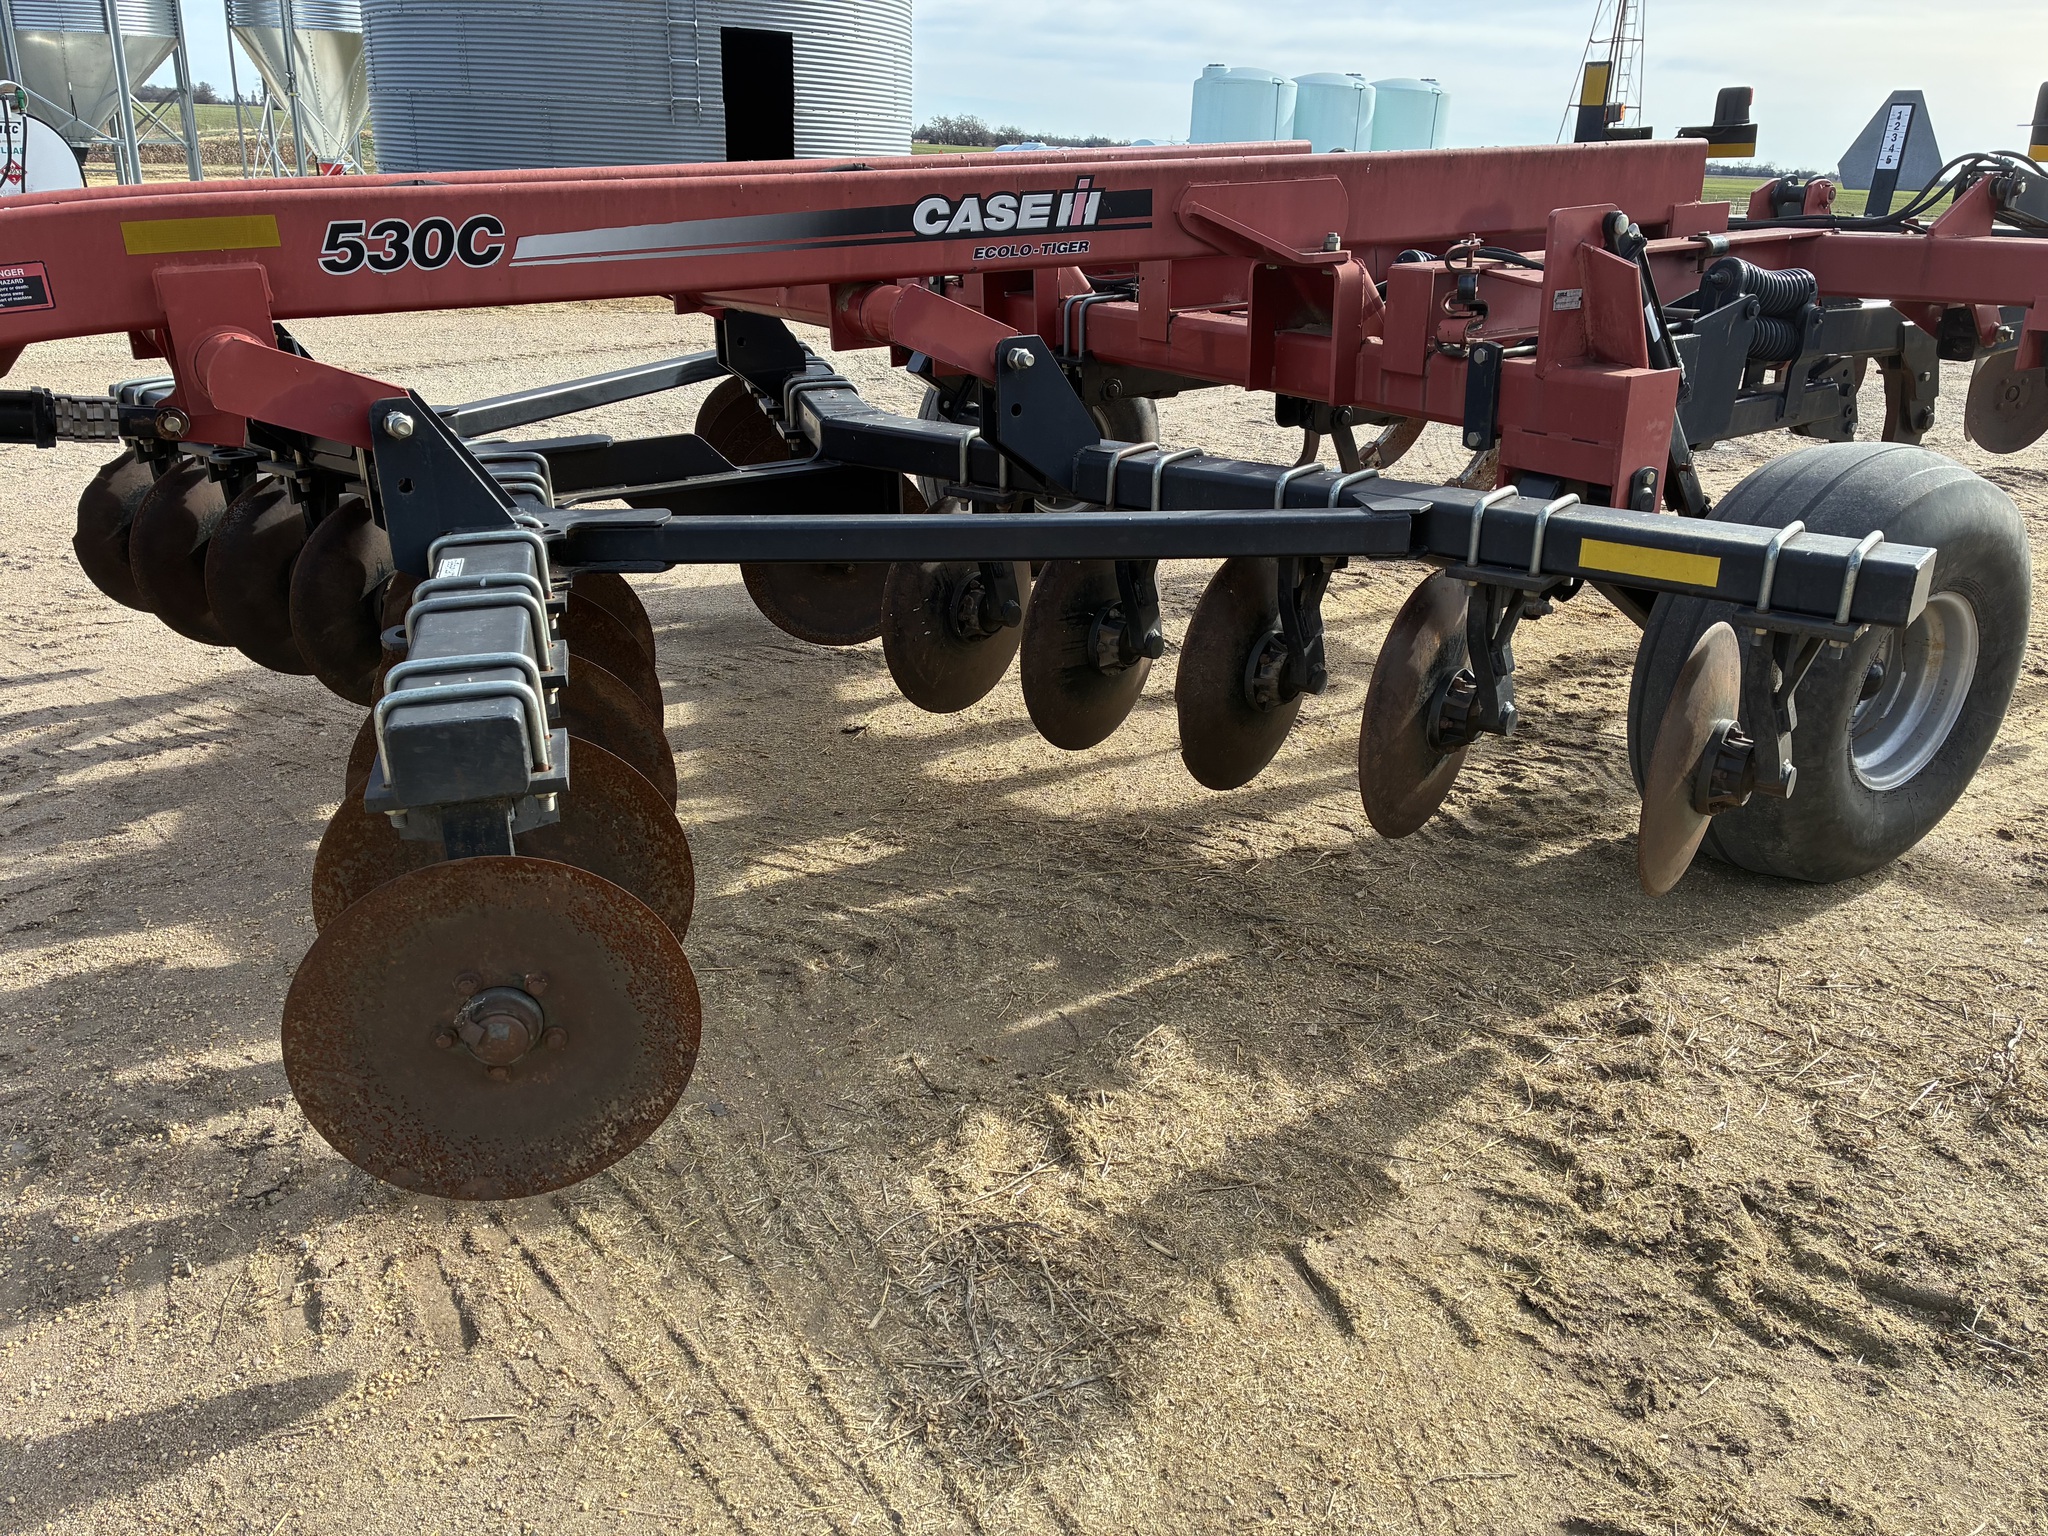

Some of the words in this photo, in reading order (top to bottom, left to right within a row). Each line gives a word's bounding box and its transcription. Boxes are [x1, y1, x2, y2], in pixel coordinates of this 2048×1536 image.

[1897, 111, 1902, 120] 1
[1894, 122, 1900, 130] 2
[1891, 133, 1897, 142] 3
[1888, 144, 1895, 153] 4
[1886, 155, 1892, 164] 5
[912, 192, 1054, 236] CASE
[318, 214, 505, 275] 530C
